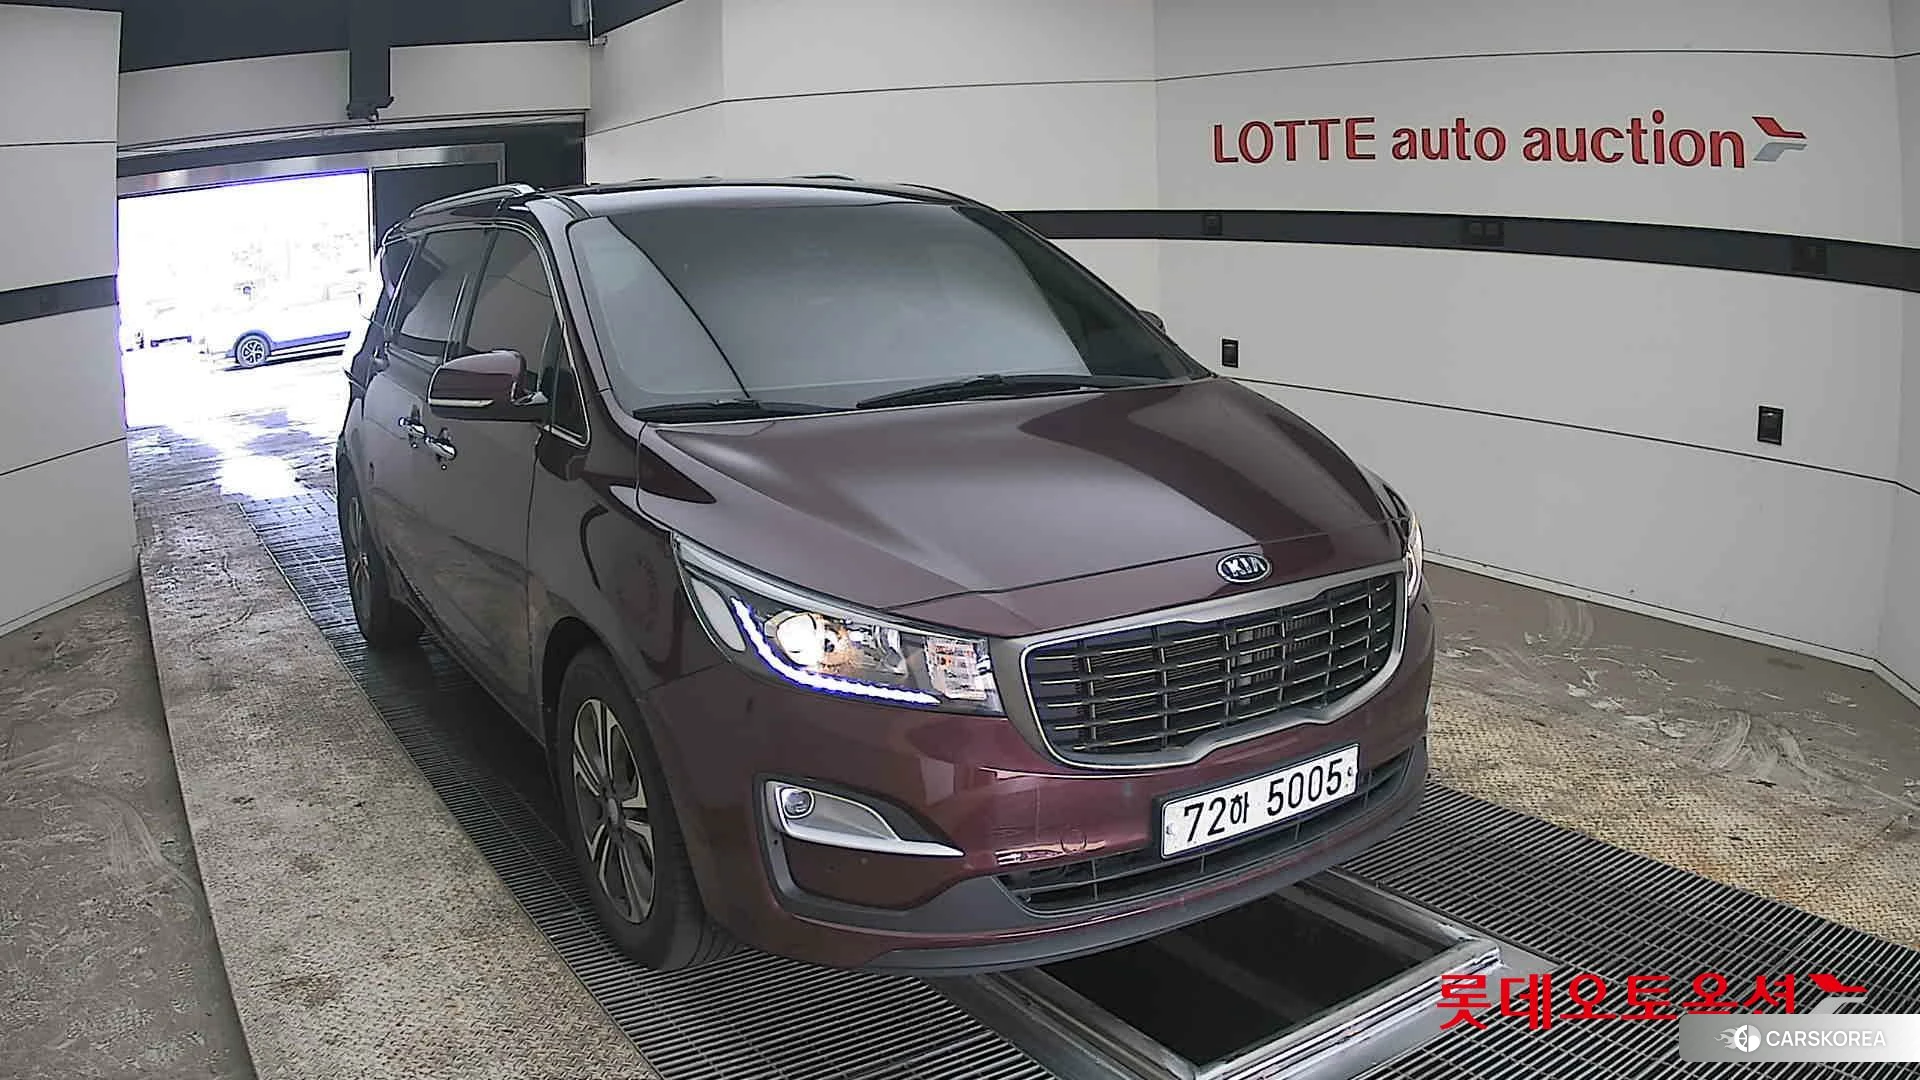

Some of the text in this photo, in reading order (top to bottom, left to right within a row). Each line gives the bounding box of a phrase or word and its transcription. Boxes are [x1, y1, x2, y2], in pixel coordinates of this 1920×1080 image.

[1212, 109, 1746, 169] LOTTE auto auction
[1224, 556, 1266, 577] KIA
[1183, 758, 1344, 843] 72하 5005
